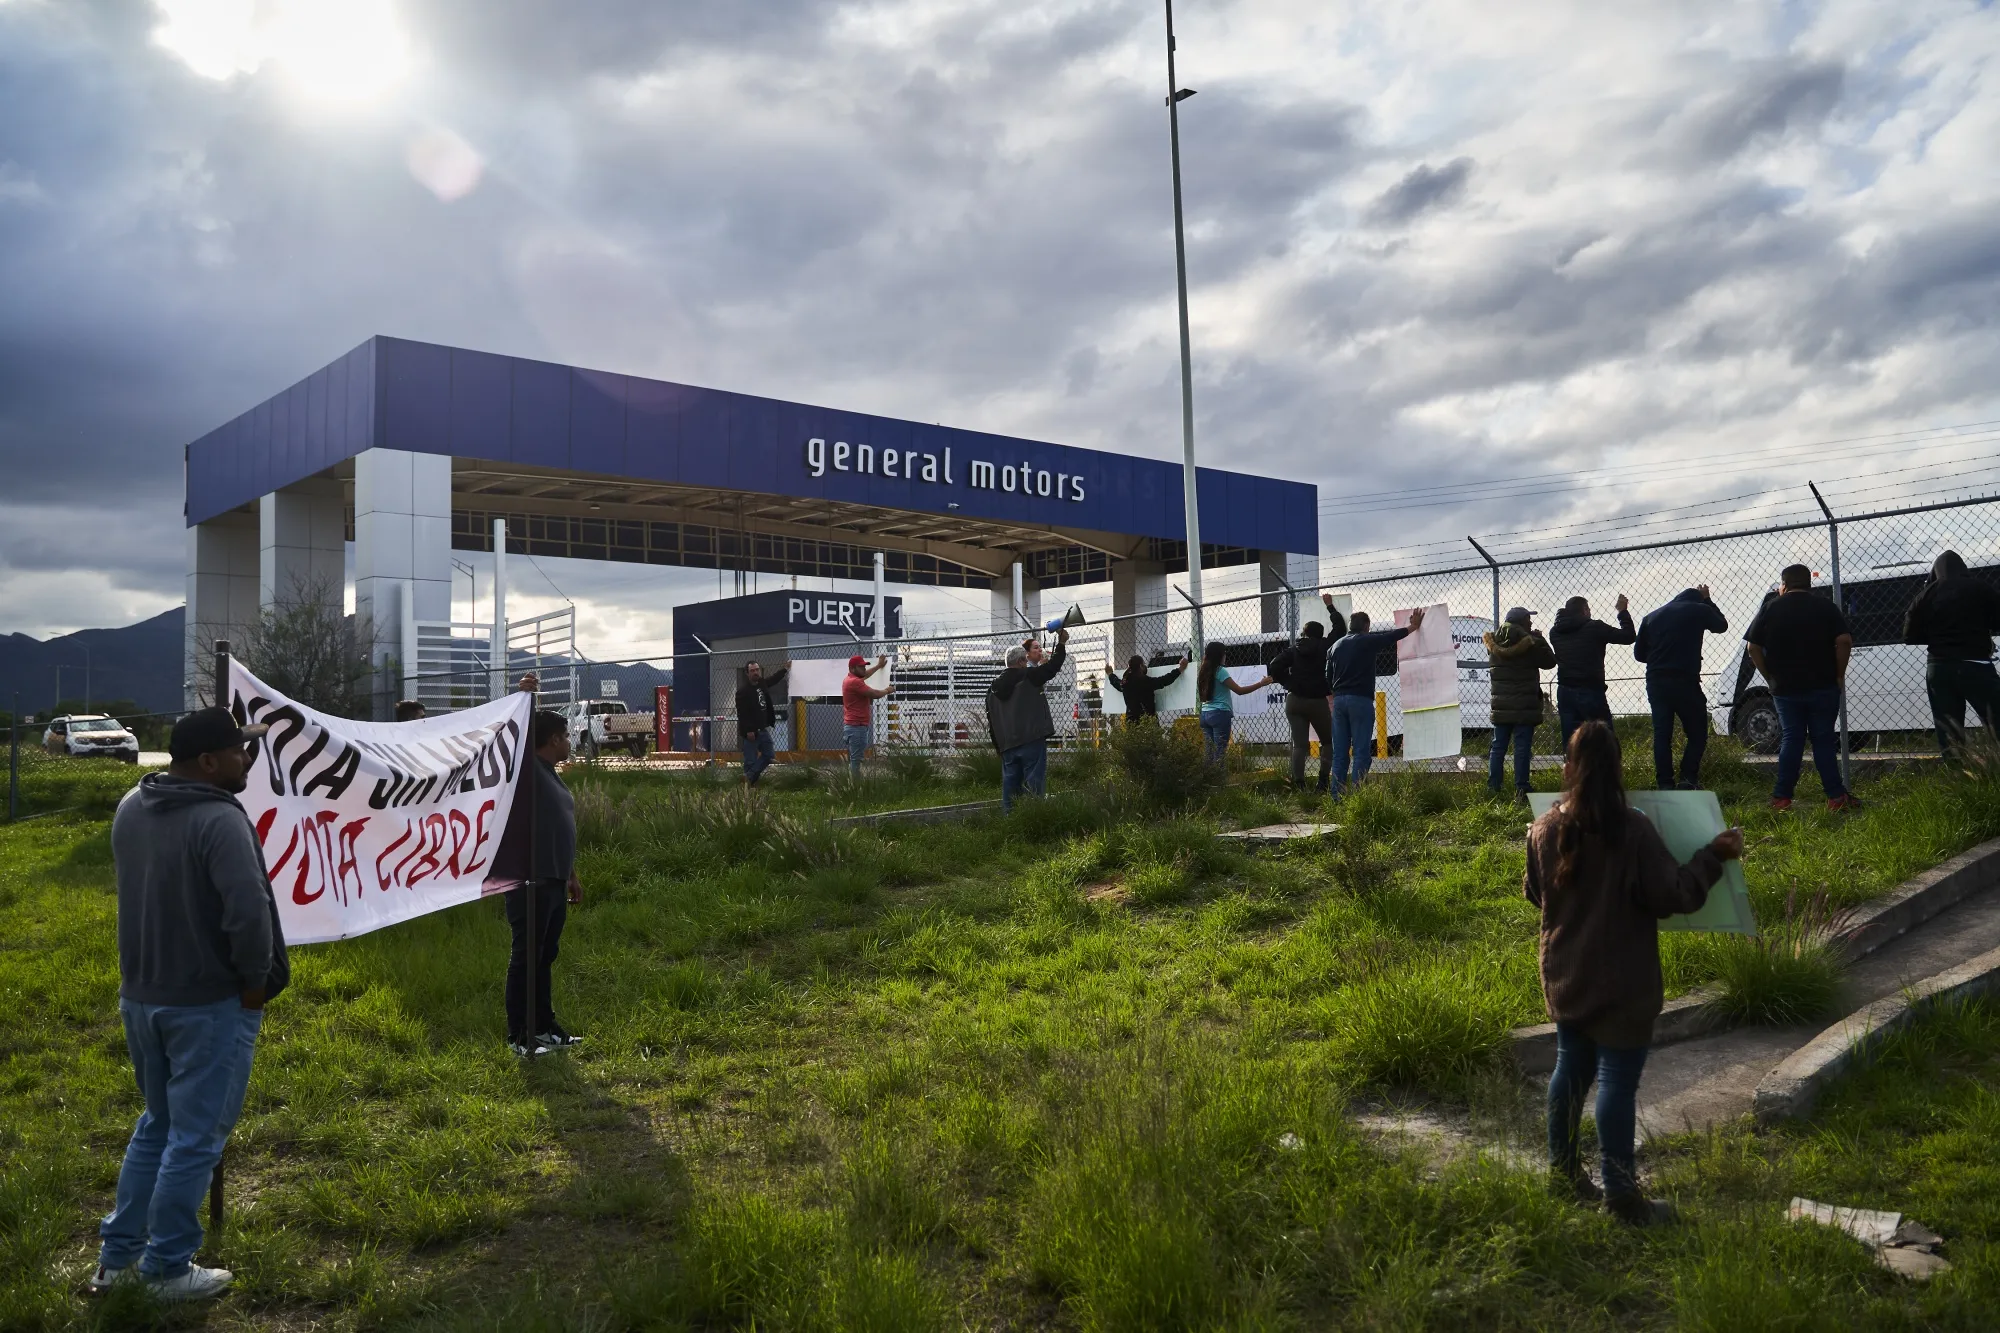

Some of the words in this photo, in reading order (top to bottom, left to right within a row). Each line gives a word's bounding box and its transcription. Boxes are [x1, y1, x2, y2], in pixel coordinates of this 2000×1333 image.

[808, 437, 953, 484] general
[971, 458, 1085, 502] motors
[375, 799, 495, 892] LIBRE
